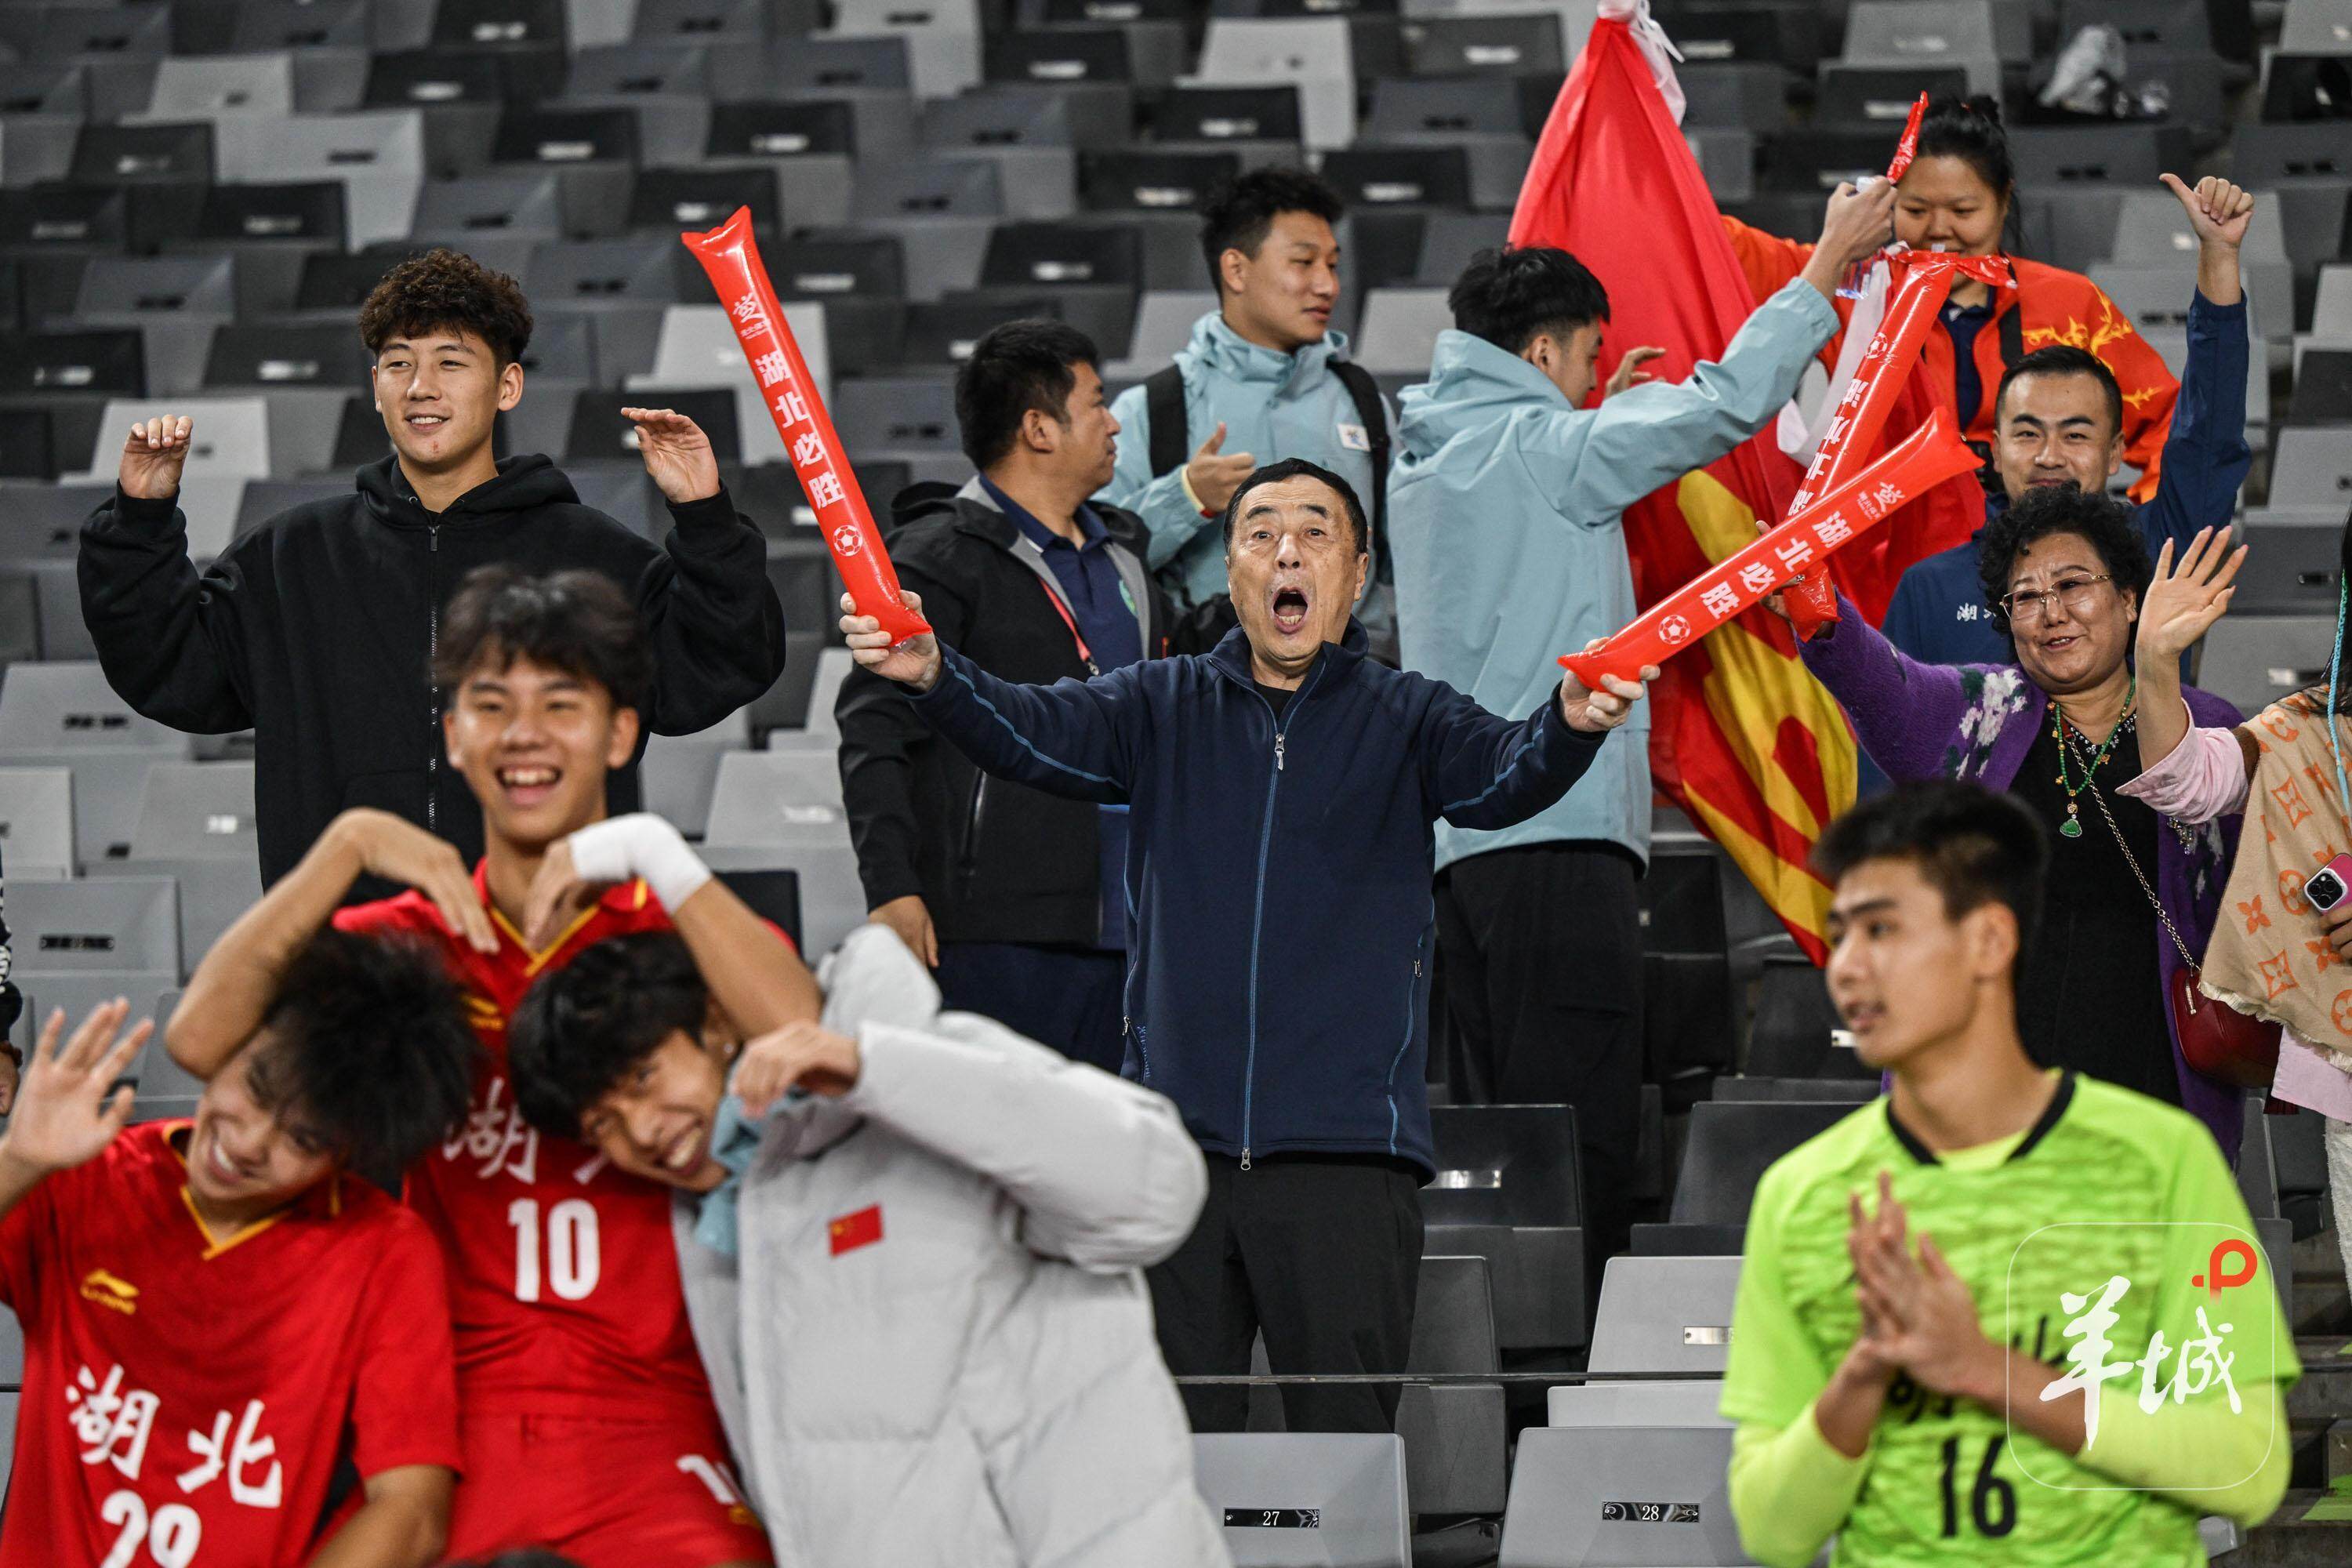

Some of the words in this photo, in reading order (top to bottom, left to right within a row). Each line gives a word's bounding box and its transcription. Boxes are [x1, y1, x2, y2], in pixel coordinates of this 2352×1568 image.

[755, 349, 845, 510] 湖北必胜
[1700, 510, 1854, 619] 湖北必胜
[508, 1198, 600, 1302] 10
[65, 1363, 283, 1509] 湖北
[1940, 1435, 2017, 1538] 16
[1263, 1511, 1279, 1526] 27
[1642, 1505, 1659, 1521] 28
